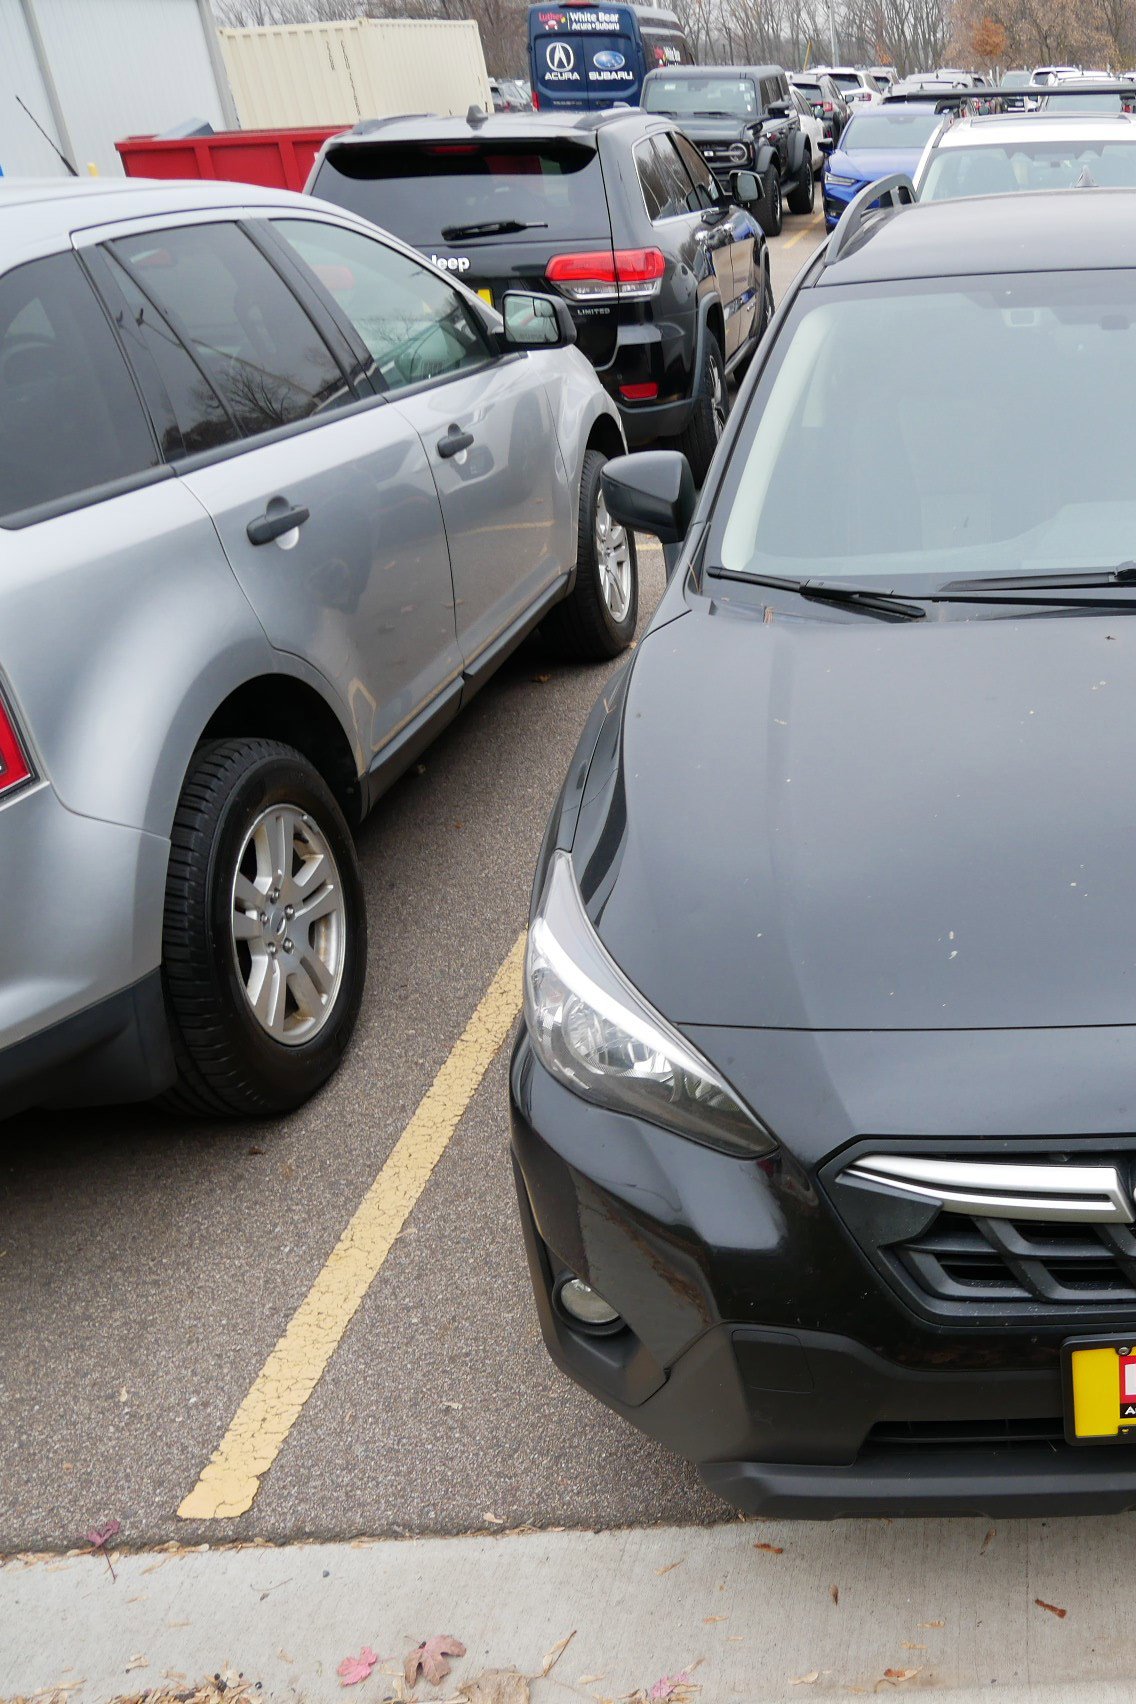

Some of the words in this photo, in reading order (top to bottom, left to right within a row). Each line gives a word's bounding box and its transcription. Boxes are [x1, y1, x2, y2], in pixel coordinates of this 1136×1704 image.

[570, 12, 597, 22] White
[598, 12, 619, 22] Bear
[544, 72, 580, 80] ACURA
[588, 71, 633, 80] SUBARU
[577, 307, 611, 316] LIMITED
